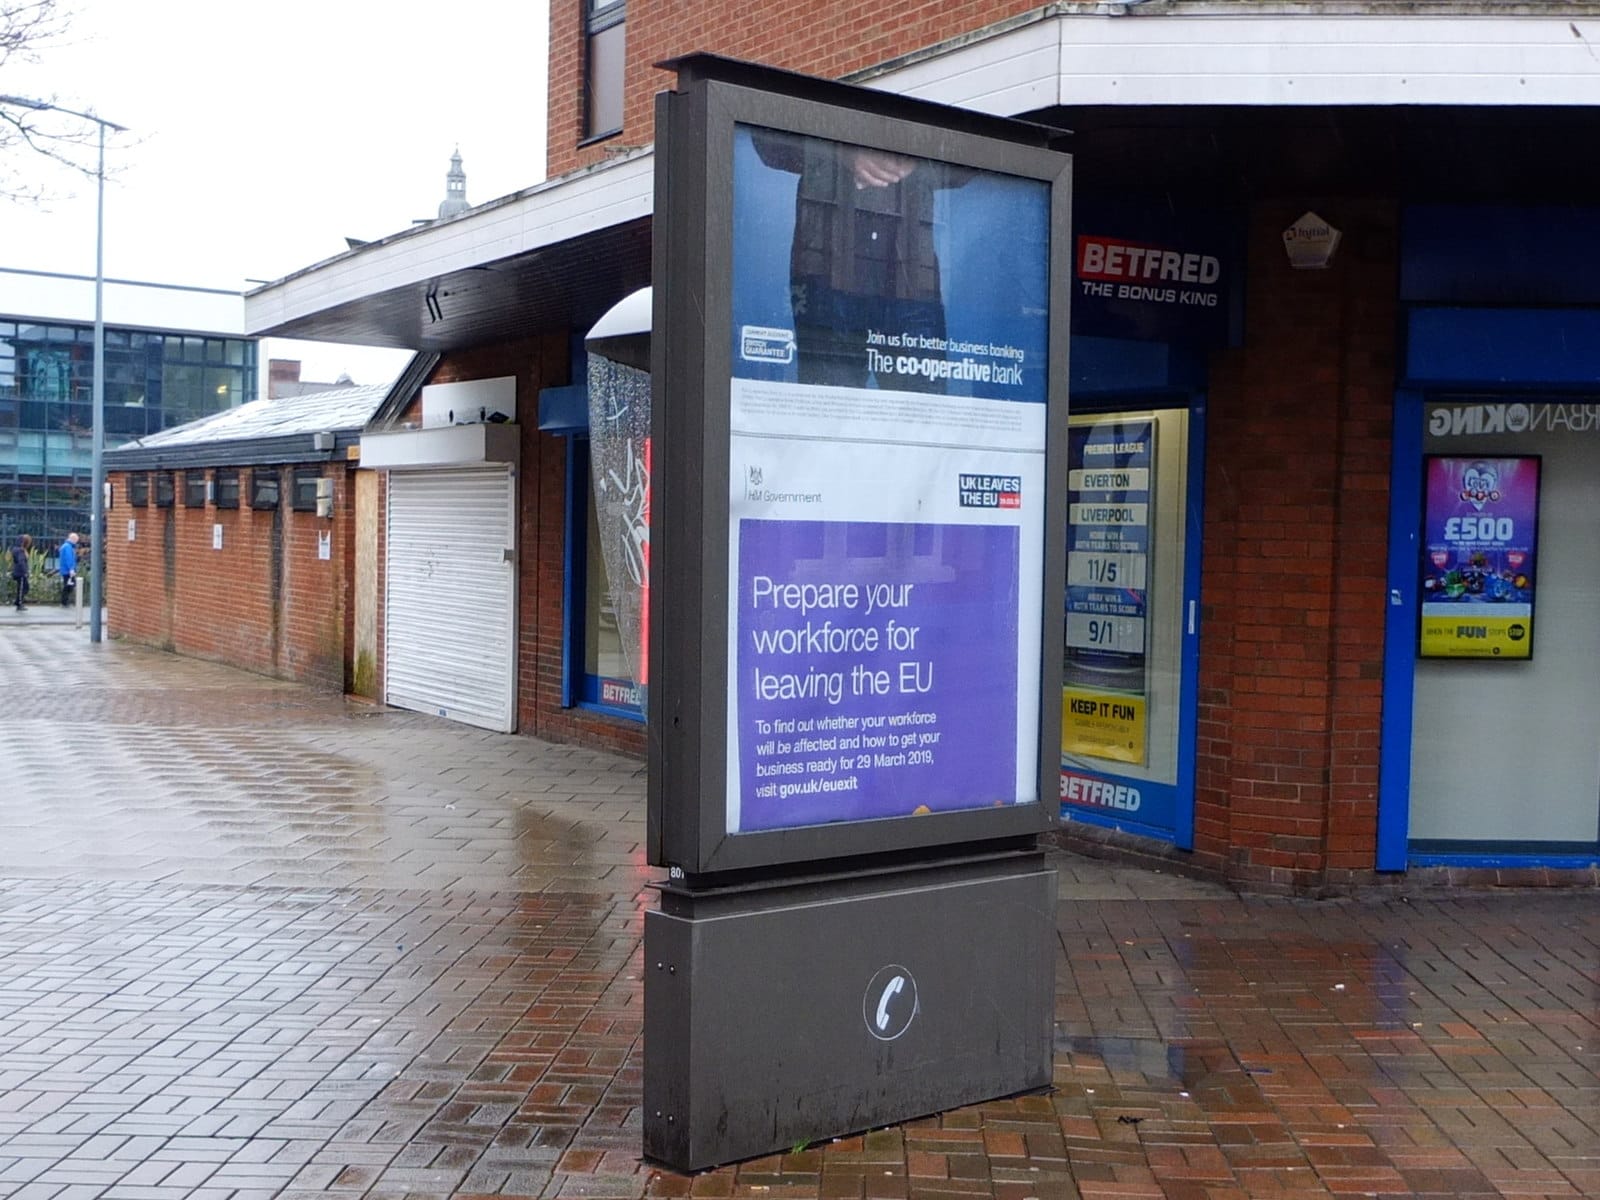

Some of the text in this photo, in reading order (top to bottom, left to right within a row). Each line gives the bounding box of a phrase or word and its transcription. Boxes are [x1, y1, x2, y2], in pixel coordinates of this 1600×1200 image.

[1082, 242, 1220, 284] BETFRED
[1082, 281, 1218, 307] THE BONUS KING
[866, 329, 1024, 362] Join us for better business banking
[866, 348, 1024, 386] The co-operative bank
[960, 475, 1020, 492] UK LEAVES
[1084, 472, 1130, 488] EVERTON
[763, 489, 822, 503] Government
[961, 491, 981, 505] THE
[983, 491, 998, 506] EU
[1081, 507, 1134, 523] LIVERPOOL
[1444, 516, 1514, 541] £500
[1087, 558, 1117, 583] 11/5
[753, 576, 914, 616] Prepare your
[752, 620, 920, 654] workforce for
[1089, 620, 1113, 644] 9/1
[1456, 626, 1487, 639] FUN
[755, 661, 933, 704] leaving the EU
[1070, 698, 1135, 721] KEEP IT FUN
[755, 711, 936, 735] To find out whether your workforce
[757, 731, 941, 756] will be affected and how to get your
[756, 750, 934, 777] business ready for 29 March 2019,
[756, 776, 858, 799] visit gov.uk/euexit
[1060, 774, 1141, 811] BETFRED
